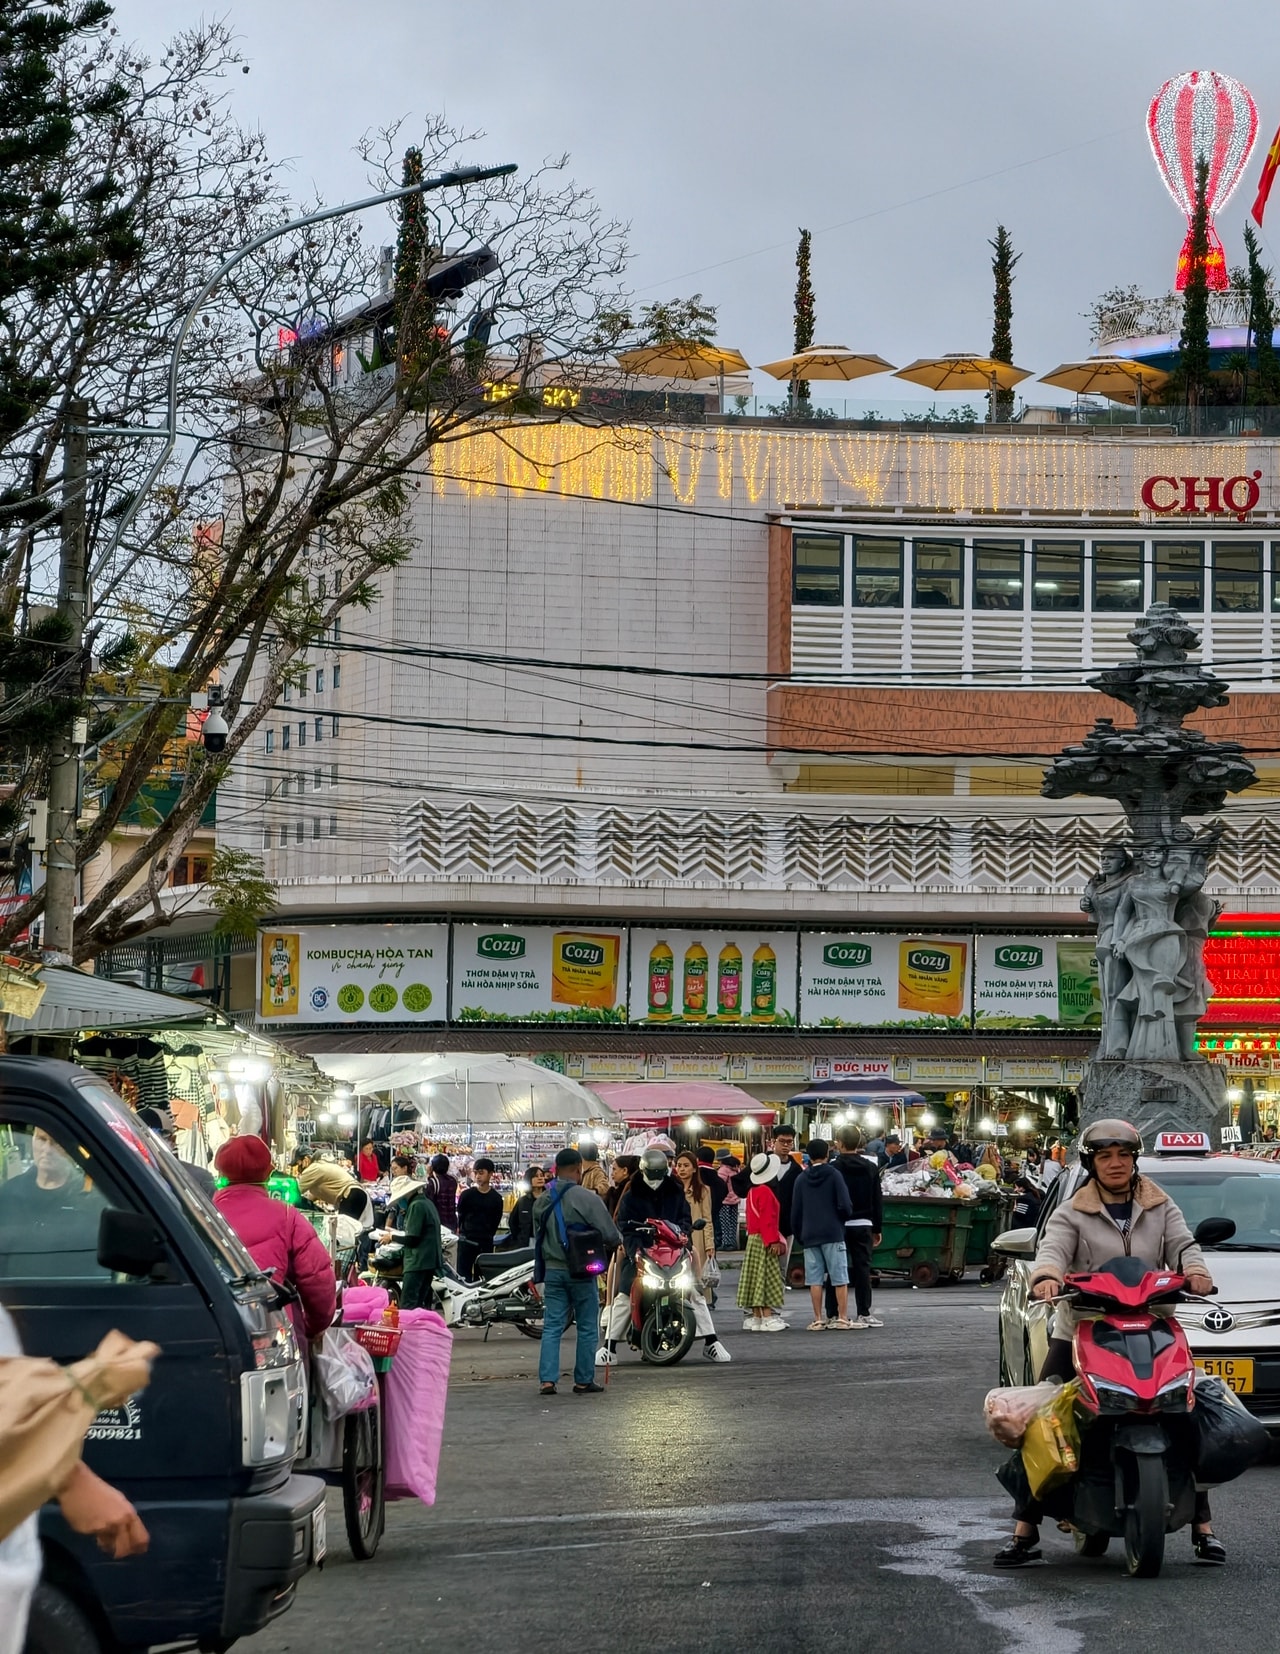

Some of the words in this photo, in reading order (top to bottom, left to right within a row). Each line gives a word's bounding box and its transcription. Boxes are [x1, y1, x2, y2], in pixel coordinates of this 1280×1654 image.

[543, 387, 580, 407] SKY
[1141, 470, 1262, 522] CHỢ
[482, 937, 521, 955] Cozy
[307, 949, 372, 960] KOMBUCHA
[376, 947, 404, 959] HÒA
[407, 948, 433, 959] TAN
[565, 945, 599, 963] Cozy
[828, 946, 867, 963] Cozy
[999, 949, 1038, 966] Cozy
[911, 952, 946, 970] Cozy
[466, 969, 490, 978] THƠM
[510, 969, 518, 979] VỊ
[520, 969, 536, 978] TRÀ
[461, 980, 476, 988] HÀI
[477, 980, 494, 988] HÒA
[495, 981, 515, 990] NHỊP
[812, 977, 836, 986] THƠM
[857, 977, 865, 987] VỊ
[866, 977, 882, 986] TRÀ
[984, 980, 1007, 989] THƠM
[1028, 980, 1036, 990] VỊ
[1038, 980, 1054, 989] TRÀ
[808, 987, 821, 996] HÀI
[823, 987, 840, 996] HÒA
[841, 988, 862, 998] NHỊP
[979, 989, 993, 998] HÀI
[995, 989, 1012, 998] HÒA
[1013, 990, 1033, 1000] NHỊP
[1062, 993, 1094, 1007] MATCHA
[834, 1062, 859, 1072] ĐỨC
[863, 1064, 889, 1072] HUY
[1164, 1133, 1202, 1145] TAXI
[1223, 1129, 1239, 1142] 40k
[1204, 1361, 1234, 1375] 51G
[83, 1428, 141, 1440] 909821
